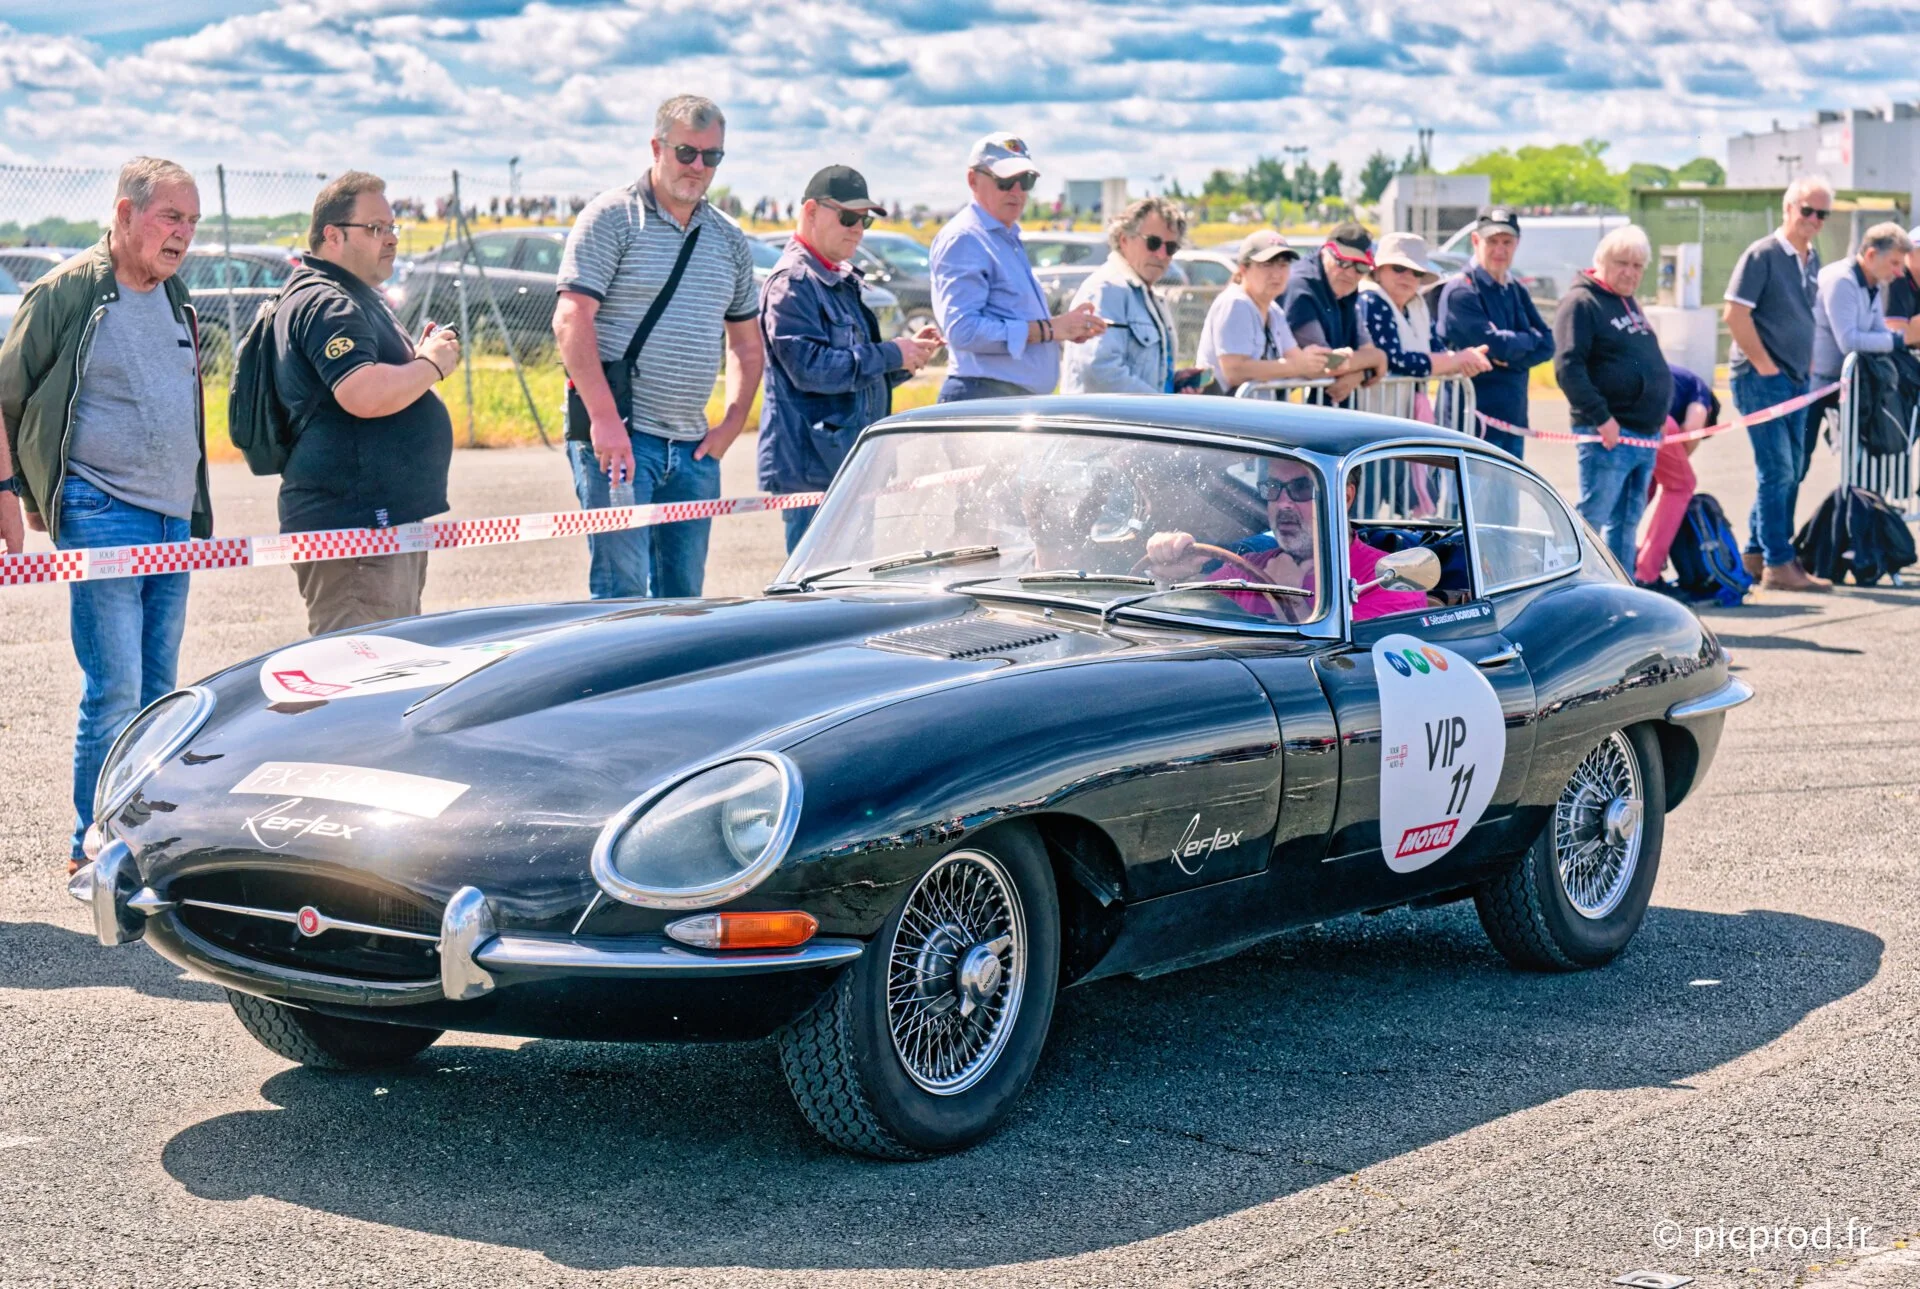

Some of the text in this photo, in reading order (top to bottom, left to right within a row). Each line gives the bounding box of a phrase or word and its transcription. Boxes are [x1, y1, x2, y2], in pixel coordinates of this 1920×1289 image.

[329, 339, 351, 357] 63
[1424, 716, 1467, 772] VIP
[1445, 763, 1476, 815] 11
[1399, 823, 1455, 854] MOTUL
